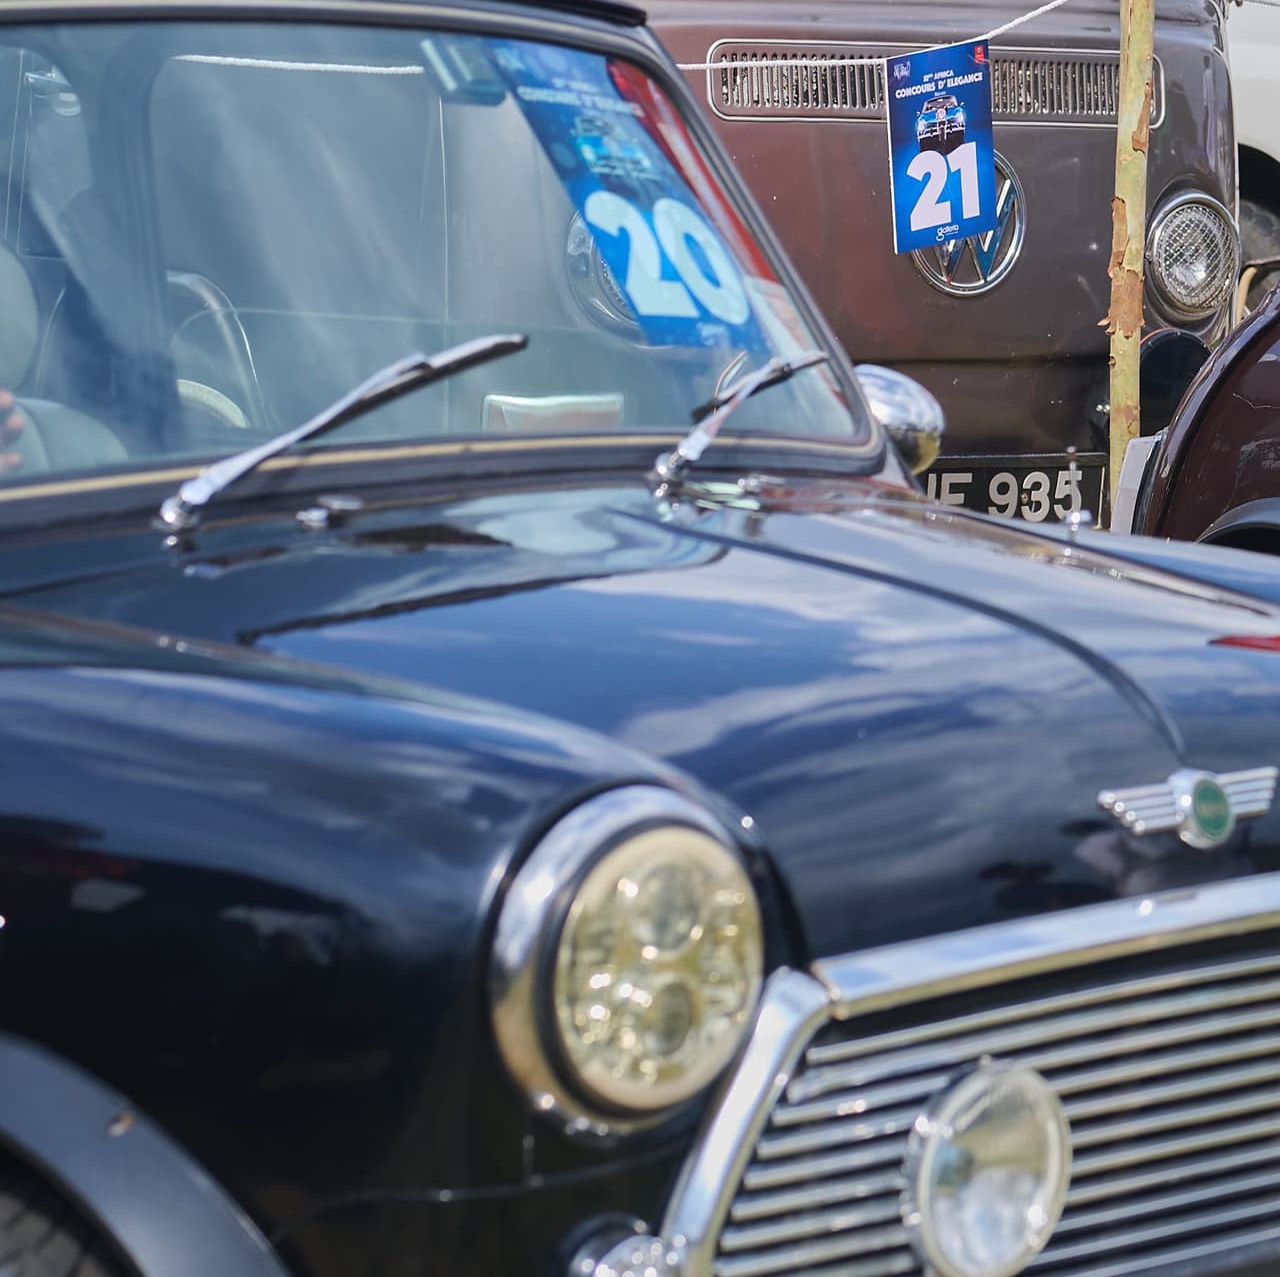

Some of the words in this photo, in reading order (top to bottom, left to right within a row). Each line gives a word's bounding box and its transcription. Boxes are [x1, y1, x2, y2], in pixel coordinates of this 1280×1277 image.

[895, 82, 936, 99] CONCOURS
[947, 72, 983, 88] ELEGANCE
[906, 141, 980, 232] 21
[584, 190, 750, 325] 20
[988, 471, 1083, 524] 935
